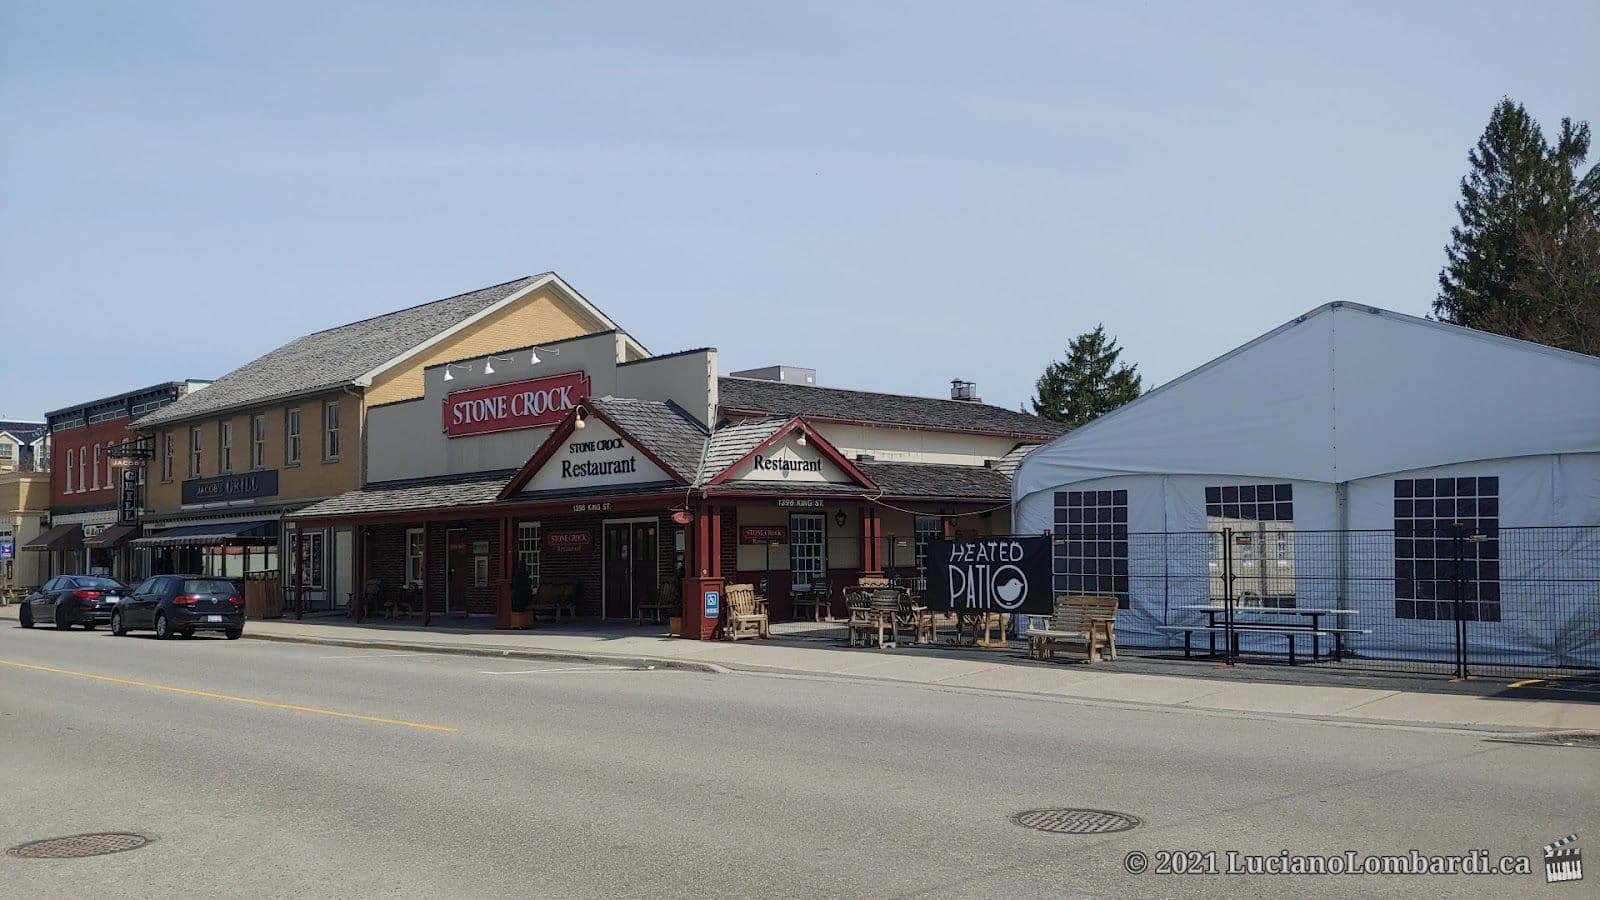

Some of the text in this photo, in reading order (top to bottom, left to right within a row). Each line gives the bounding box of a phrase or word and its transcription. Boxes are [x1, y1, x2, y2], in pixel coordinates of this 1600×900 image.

[453, 385, 576, 425] STONE CROCK
[569, 438, 625, 454] STONE CROCK
[561, 455, 637, 478] Restaurant
[754, 454, 822, 471] Restaurant
[778, 499, 794, 507] 1396
[796, 499, 813, 507] KING
[550, 533, 588, 543] STONE CROCK
[949, 541, 1024, 562] HEATED
[948, 564, 1029, 609] PATIO
